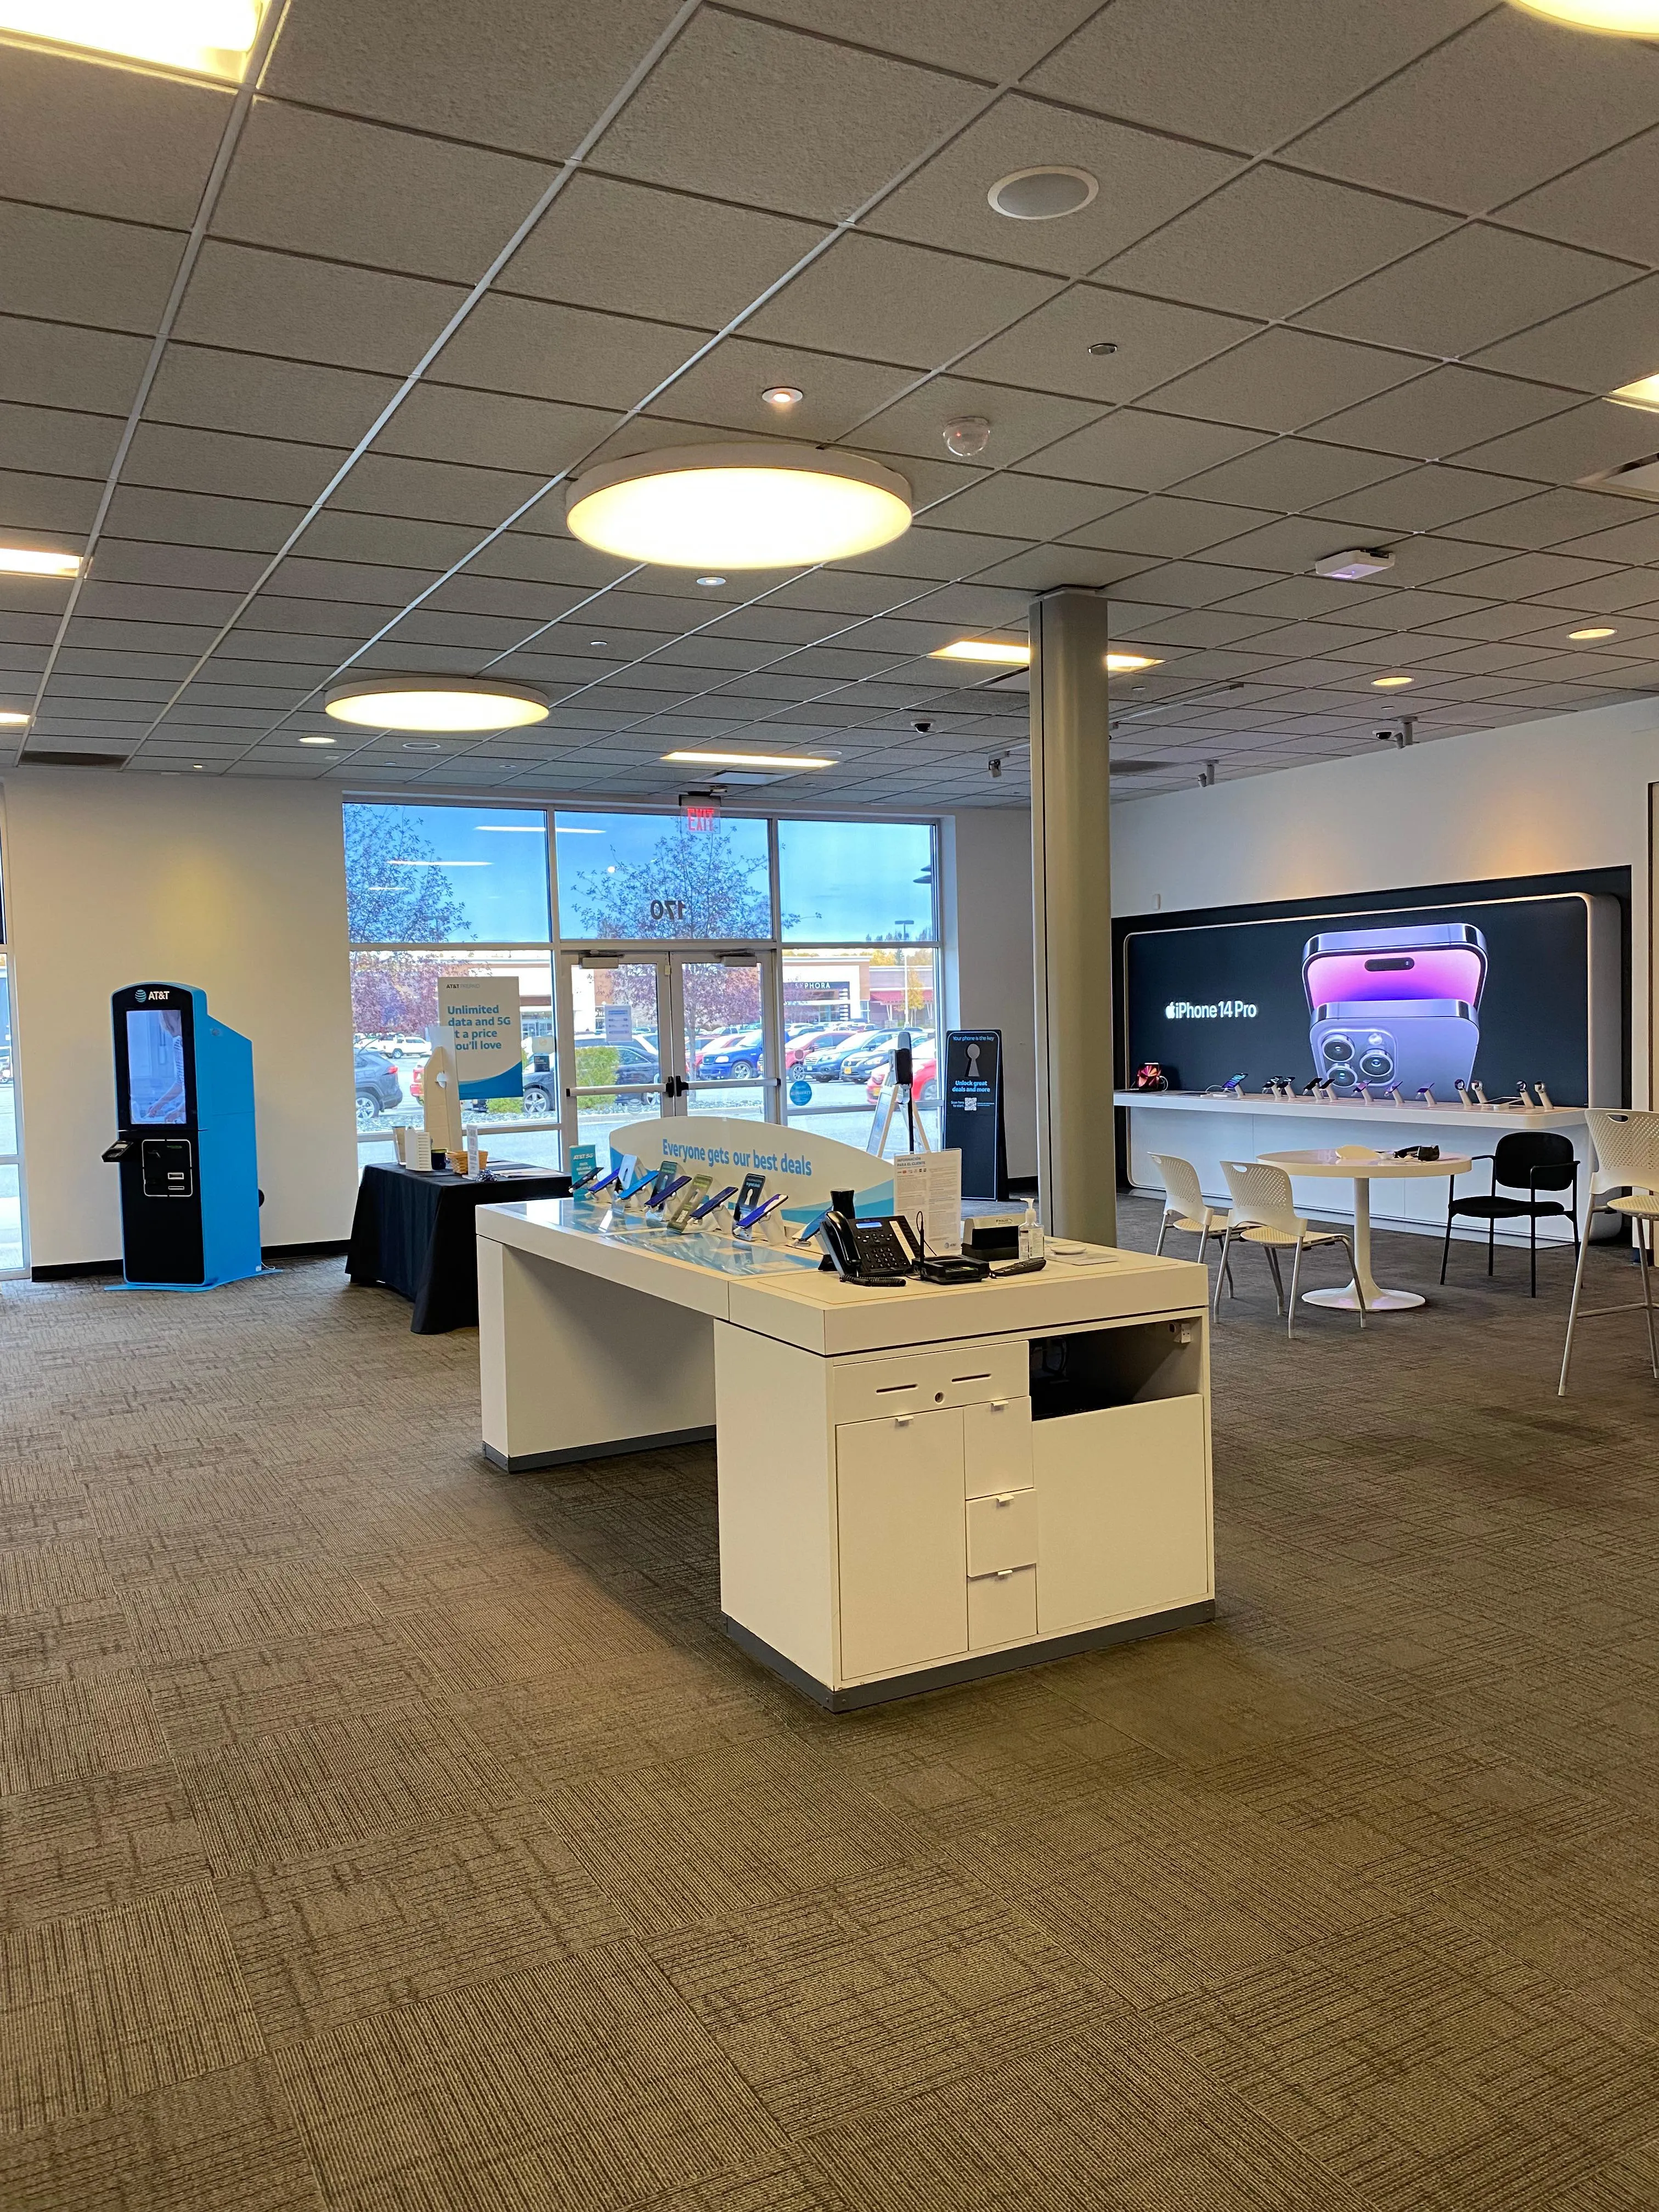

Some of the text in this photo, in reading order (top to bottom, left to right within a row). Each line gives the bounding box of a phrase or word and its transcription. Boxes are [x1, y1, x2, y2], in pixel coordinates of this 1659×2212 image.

[687, 808, 714, 831] EXIT
[148, 991, 170, 1000] AT&T
[448, 1005, 499, 1014] Unlimited
[1175, 1000, 1257, 1019] iPhone 14 Pro
[448, 1017, 511, 1026] data and 5G
[454, 1030, 460, 1039] t
[472, 1029, 498, 1040] price
[456, 1040, 502, 1050] ou'll love
[662, 1138, 812, 1176] Everyone gets our best deals
